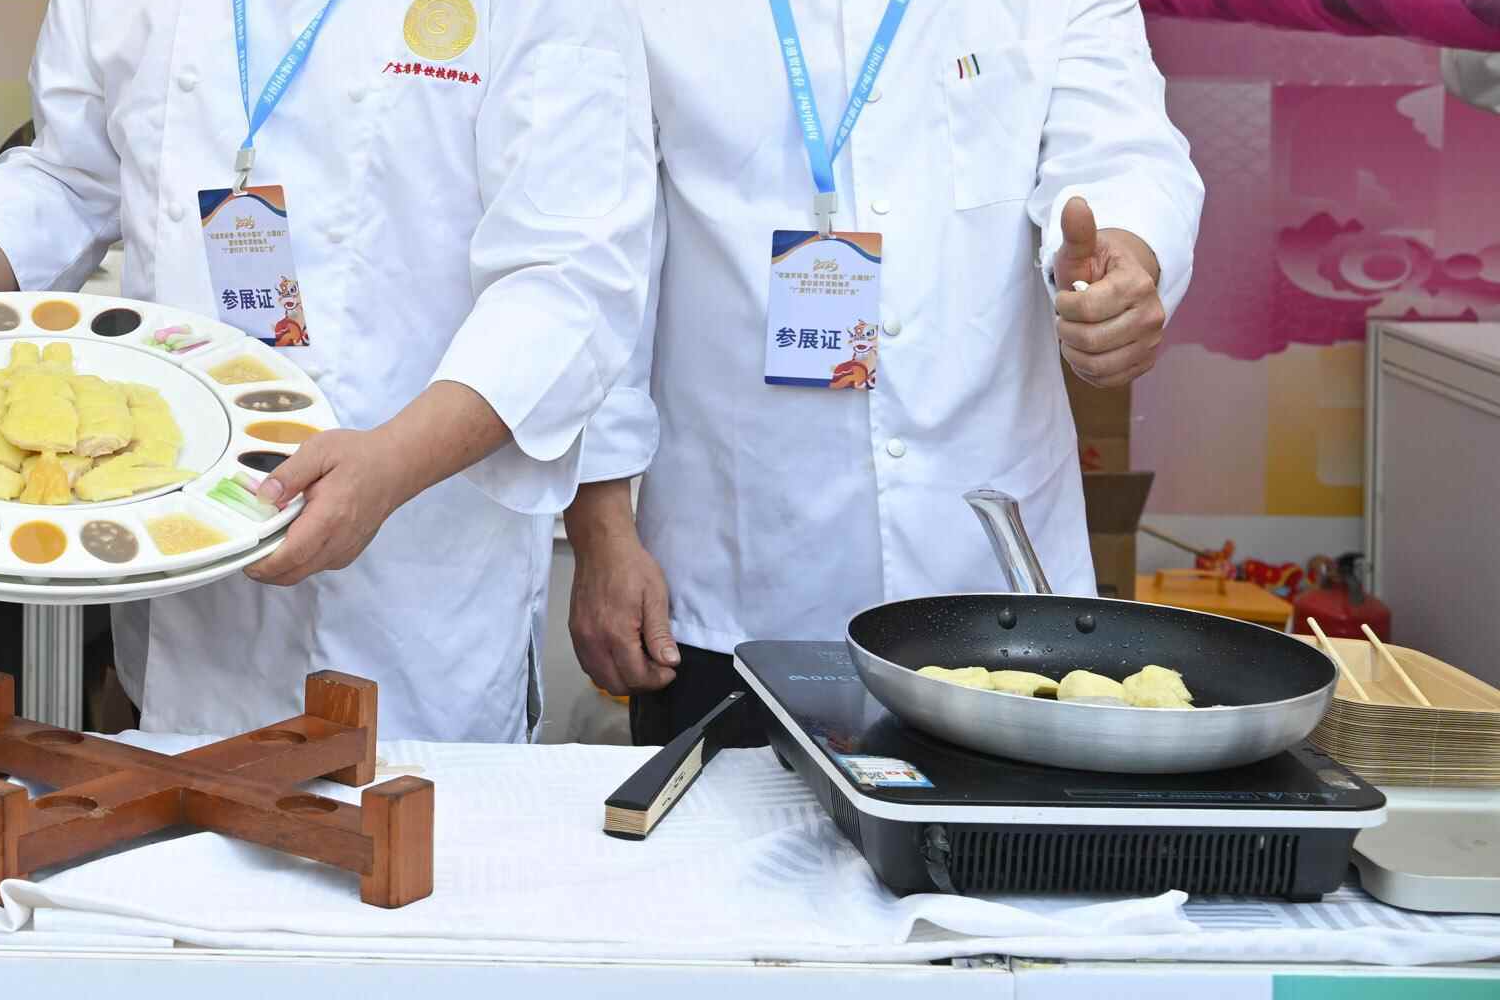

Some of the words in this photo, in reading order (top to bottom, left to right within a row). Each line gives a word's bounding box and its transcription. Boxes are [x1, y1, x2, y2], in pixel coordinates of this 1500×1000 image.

[221, 288, 275, 310] 参展证
[775, 326, 842, 350] 参展证
